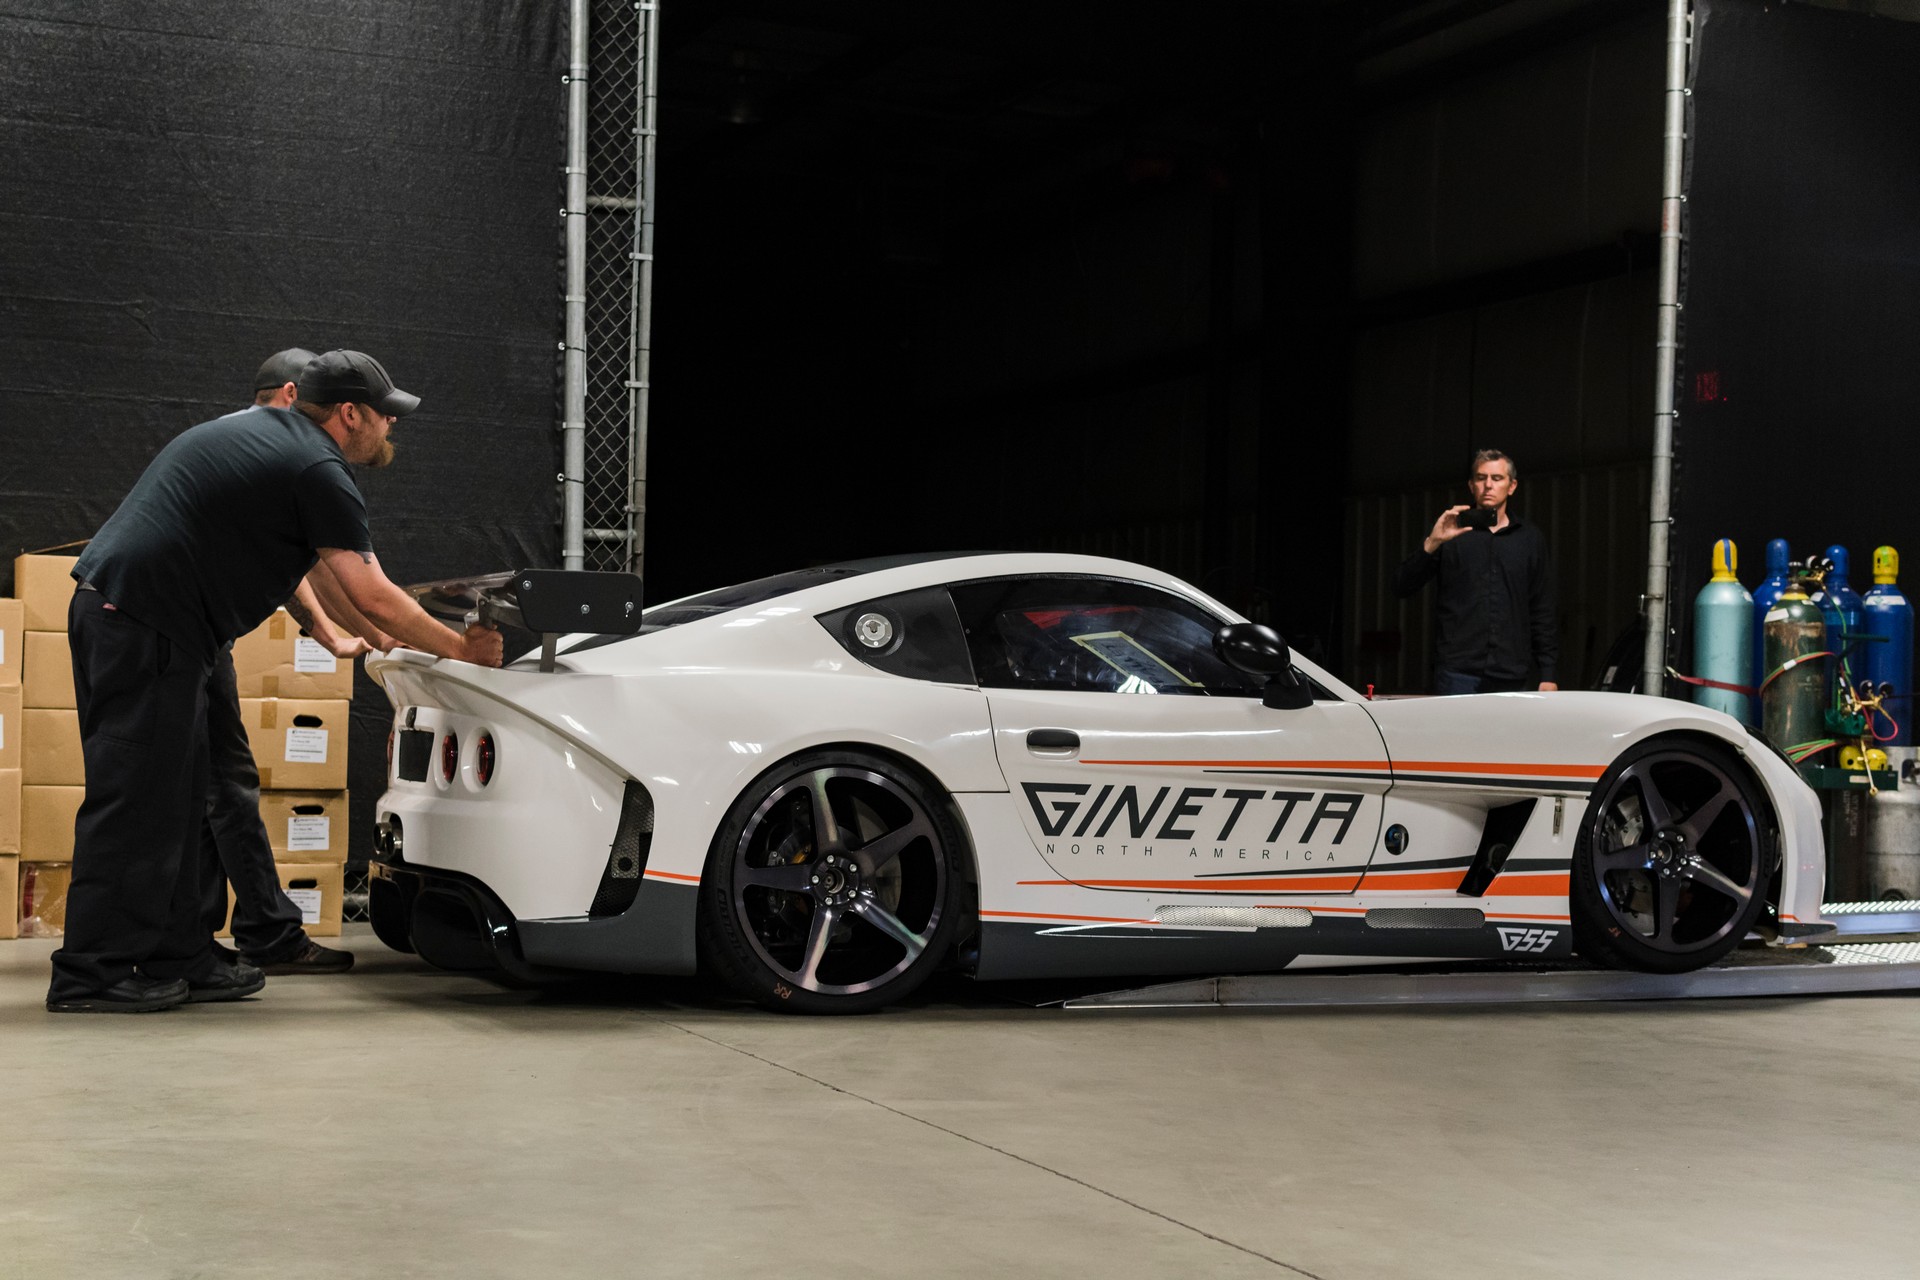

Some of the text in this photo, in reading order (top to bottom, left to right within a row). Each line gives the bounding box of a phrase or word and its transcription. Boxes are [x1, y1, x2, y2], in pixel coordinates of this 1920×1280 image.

[1020, 782, 1364, 844] GINETTA
[1046, 843, 1335, 861] NORTH AMERICA
